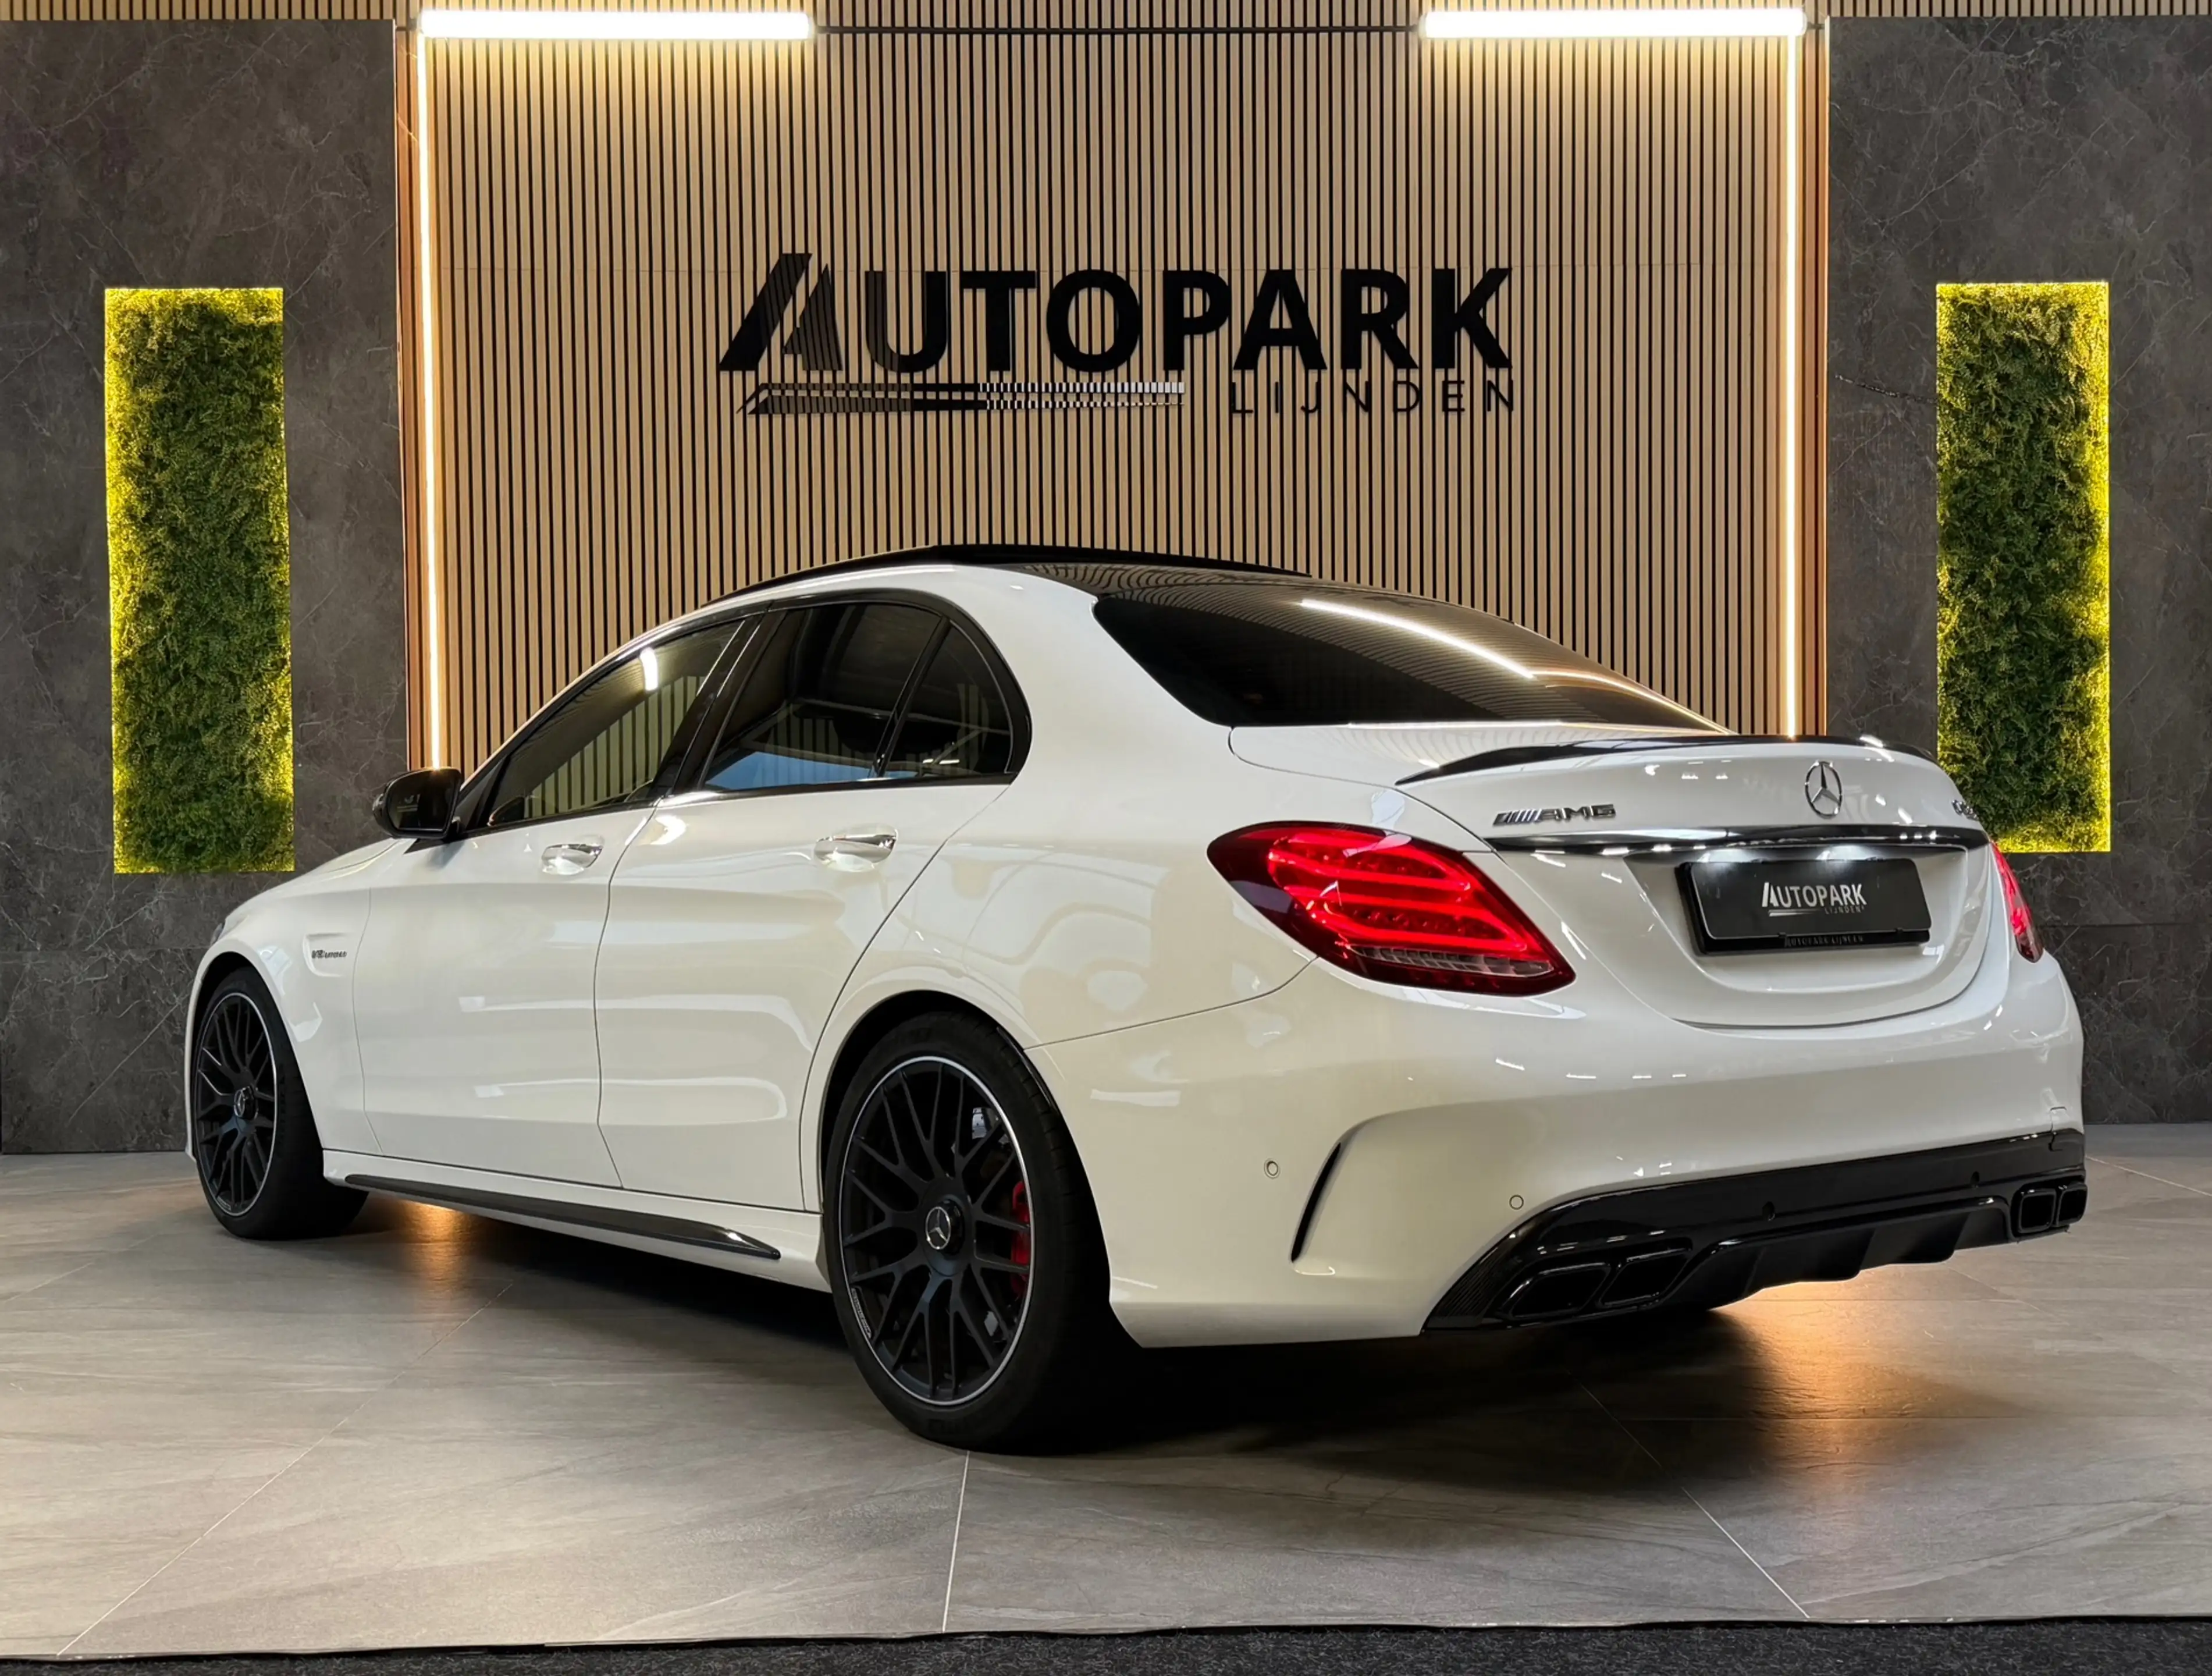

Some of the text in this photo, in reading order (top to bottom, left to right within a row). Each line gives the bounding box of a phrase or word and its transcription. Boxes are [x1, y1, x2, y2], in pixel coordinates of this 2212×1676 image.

[719, 253, 1513, 372] AUTOPARK
[1231, 379, 1514, 414] LIJNDEN
[1762, 882, 1867, 907] AUTOPARK
